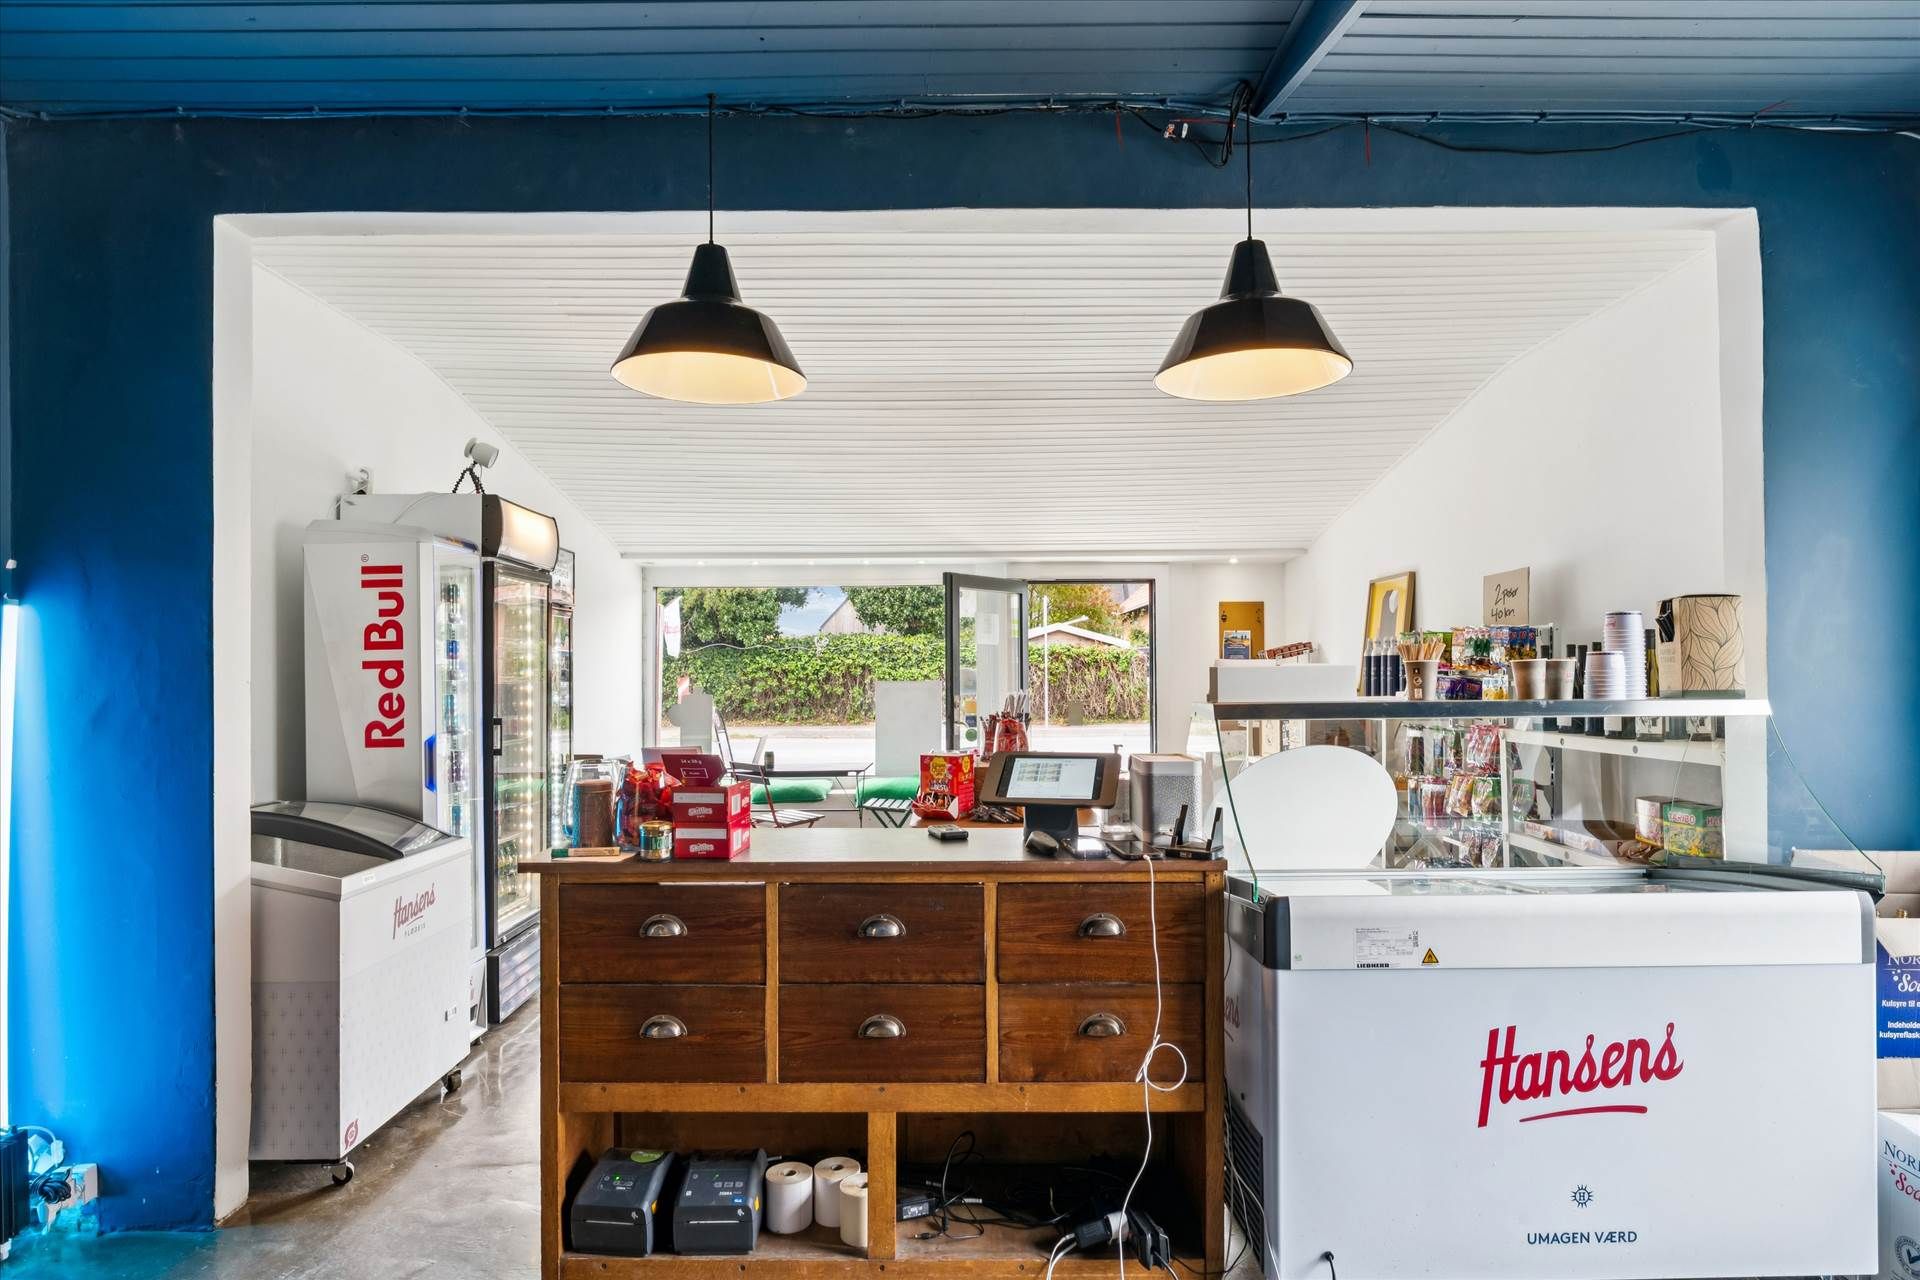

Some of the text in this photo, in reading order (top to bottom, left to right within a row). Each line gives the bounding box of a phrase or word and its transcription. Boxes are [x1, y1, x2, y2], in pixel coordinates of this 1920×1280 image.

[1494, 583, 1502, 606] 2
[1491, 608, 1504, 622] 40
[361, 564, 405, 749] Red Bull
[392, 882, 436, 940] Hansens
[1881, 1000, 1907, 1009] Kulsyre
[1477, 1022, 1684, 1128] Hansens
[1884, 1139, 1920, 1172] NOR
[1527, 1231, 1638, 1245] UMAGEN VÆRD
